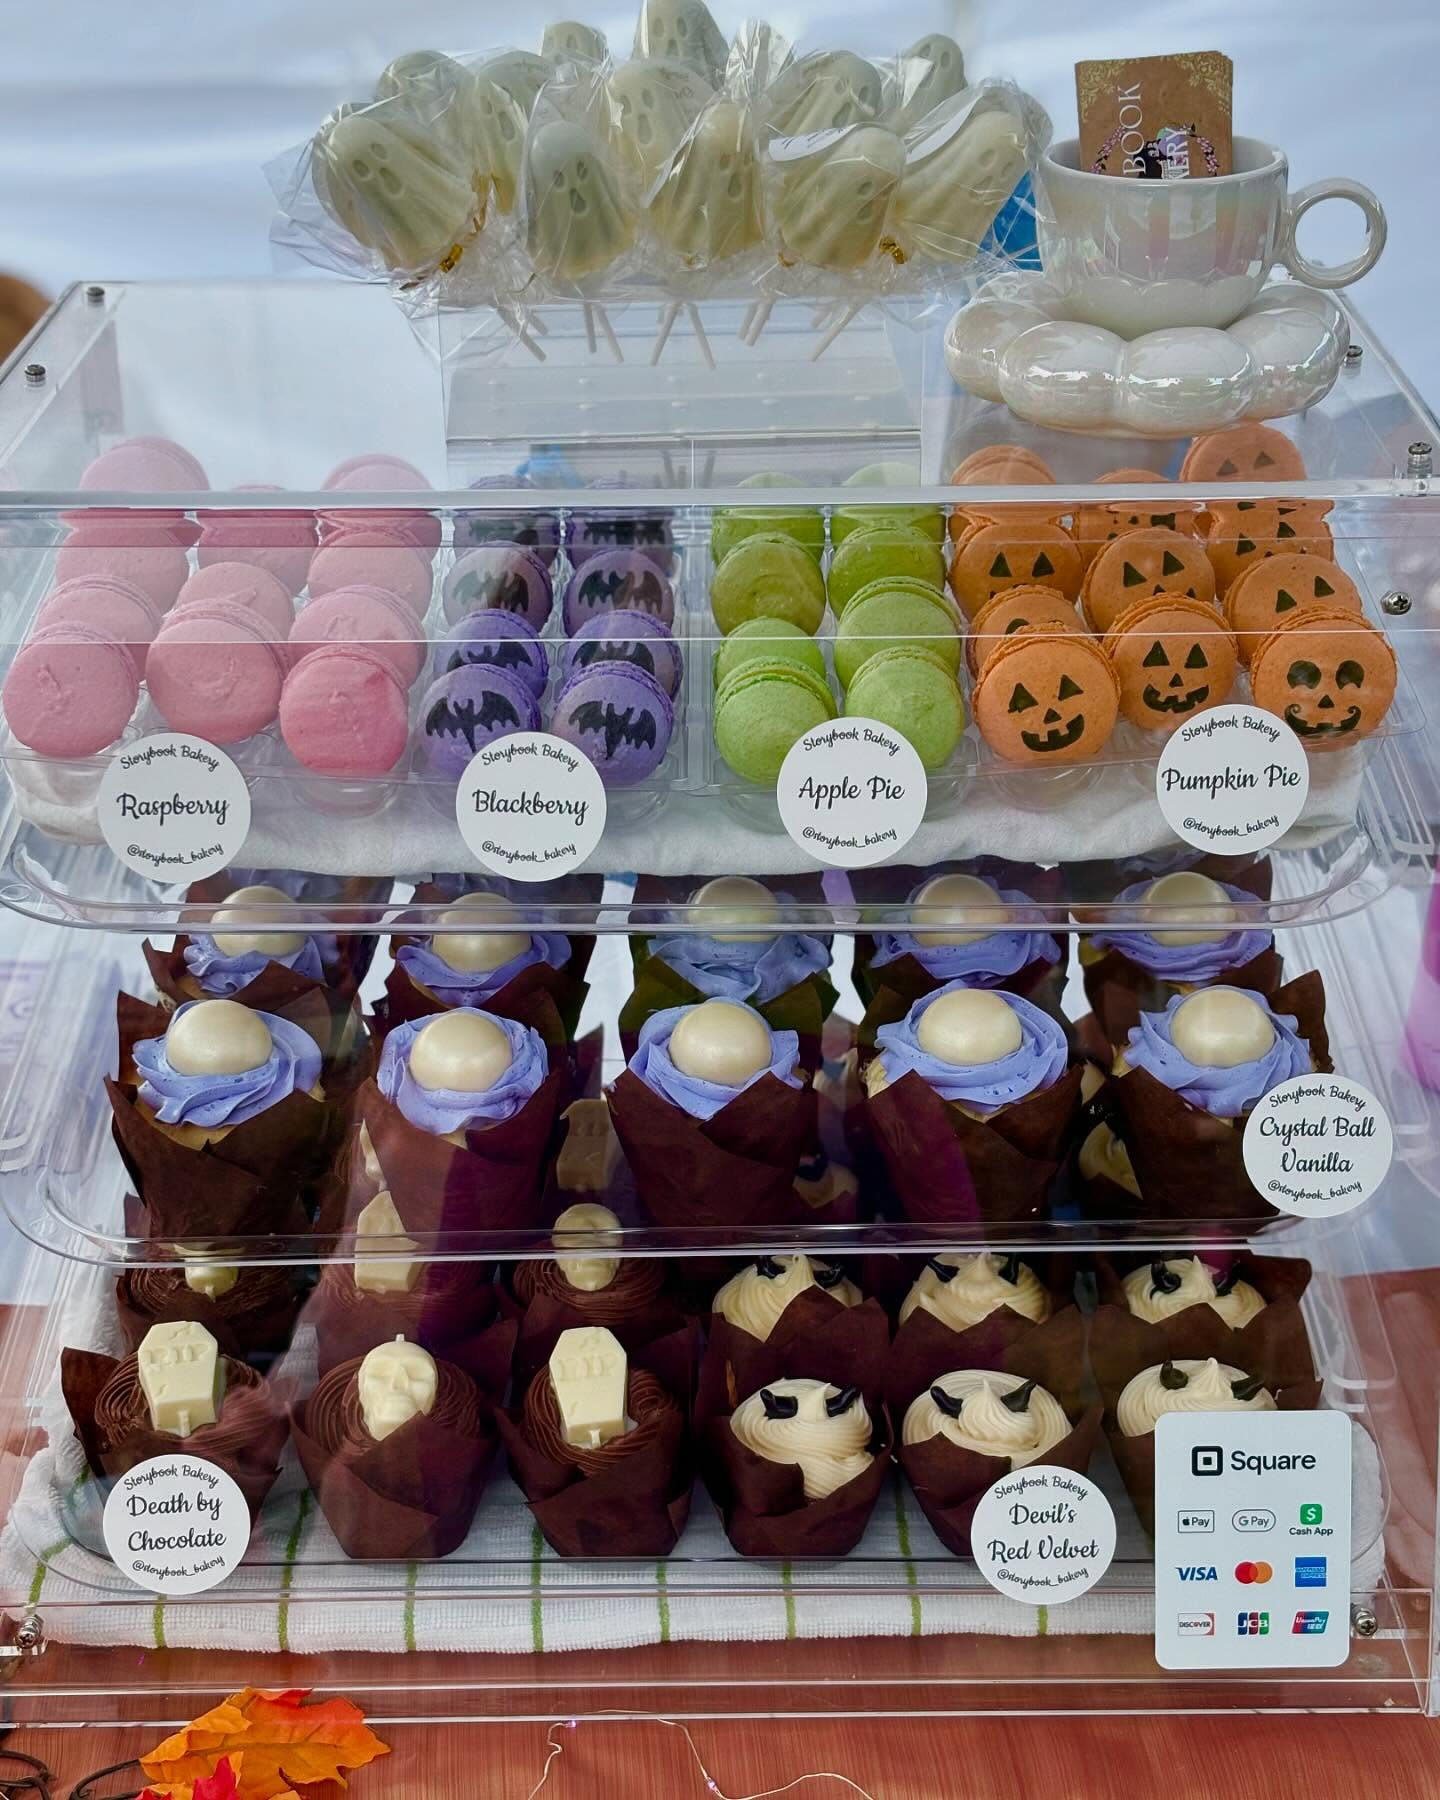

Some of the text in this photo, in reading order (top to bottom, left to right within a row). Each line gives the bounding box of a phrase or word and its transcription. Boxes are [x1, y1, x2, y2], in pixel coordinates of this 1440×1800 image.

[1181, 715, 1280, 743] Storybook Bakery
[803, 727, 901, 757] Storybook Bakery
[120, 744, 219, 772] Storybook Bakery
[481, 742, 579, 772] Storybook Bakery
[798, 775, 905, 810] Apple Pie
[1161, 763, 1301, 800] Pumpkin Pie
[116, 792, 230, 826] Raspberry
[472, 789, 589, 826] Blackberry
[802, 826, 897, 850] @storybook_bakery
[1183, 814, 1280, 839] @storybook_bakery
[127, 843, 224, 867] @storybook_bakery
[482, 840, 576, 863] @storybook_bakery
[1269, 1084, 1367, 1112] Storybook Bakery
[1259, 1115, 1377, 1147] Crystal Ball
[1280, 1148, 1354, 1173] Vanilla
[1267, 1179, 1363, 1202] @storybook_bakery
[1230, 1450, 1317, 1476] Square
[123, 1464, 220, 1491] Storybook Bakery
[994, 1474, 1089, 1501] Storybook Bakery
[126, 1491, 223, 1521] Death by
[1009, 1502, 1078, 1525] Devil's
[1191, 1516, 1210, 1528] Pay
[1251, 1516, 1270, 1528] Pay
[1289, 1527, 1334, 1537] Cash App
[127, 1528, 227, 1552] Chocolate
[987, 1535, 1100, 1563] Red Velvet
[132, 1555, 226, 1580] @storybook_bakery
[997, 1567, 1089, 1589] @storybook_bakery
[1176, 1567, 1218, 1581] VISA
[1179, 1621, 1211, 1629] DISCOVER
[1238, 1619, 1269, 1628] JCB
